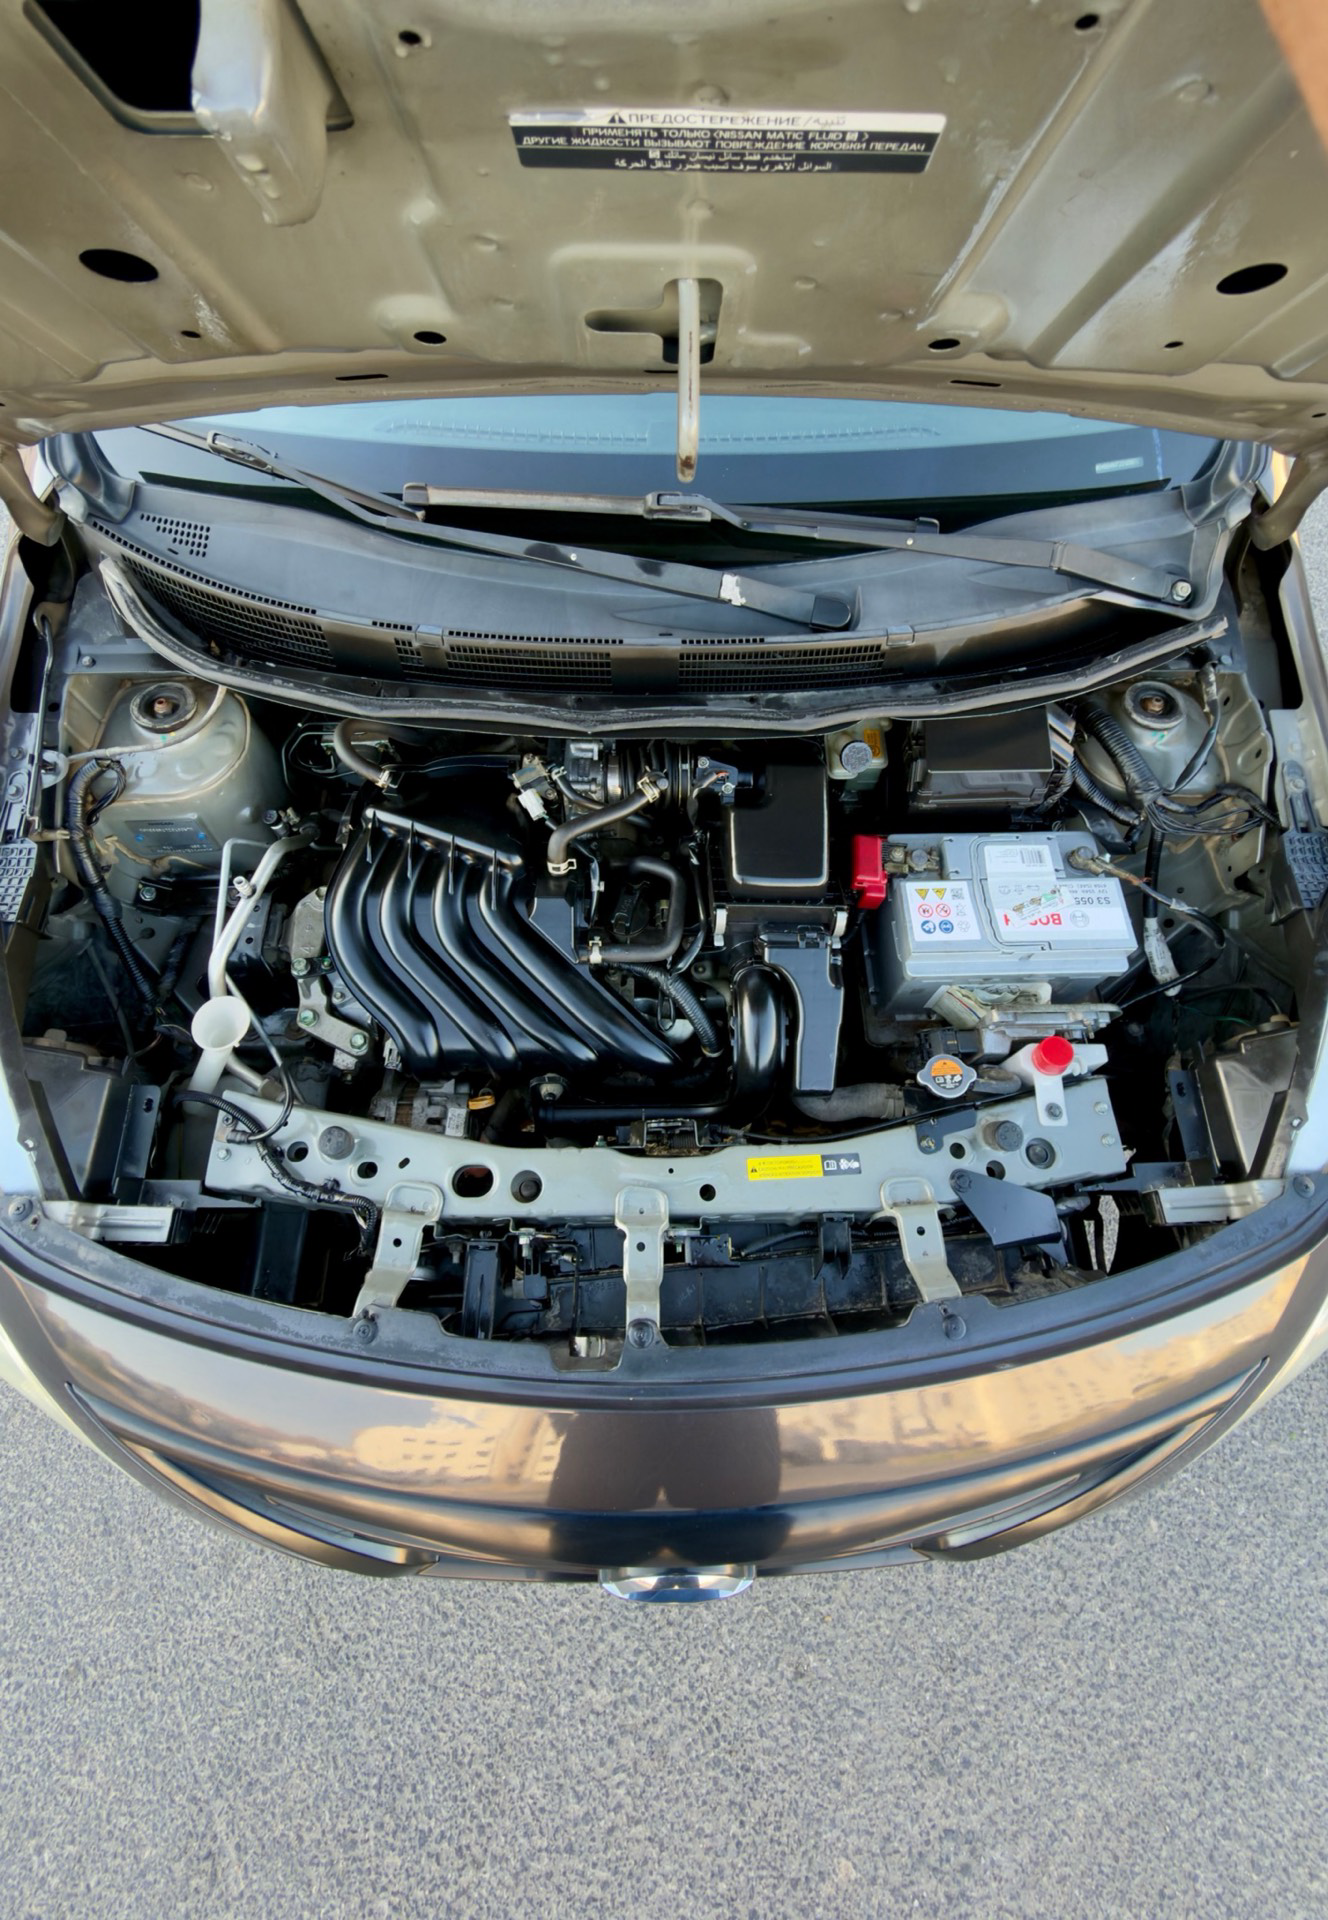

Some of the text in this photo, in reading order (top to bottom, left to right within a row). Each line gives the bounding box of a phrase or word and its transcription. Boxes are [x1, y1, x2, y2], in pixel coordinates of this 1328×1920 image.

[582, 127, 658, 138] ПРИМЕНЯТЬ
[661, 129, 711, 139] ТОЛЬКО
[766, 131, 804, 140] MATIC
[808, 131, 843, 141] FLUID
[522, 136, 926, 152] ДРУГИЕ ЖИДКОСТИ ВЫЗЫВАЮТ ПОВРЕЖДЕНИЕ КОРОБКИ ПЕРЕДАЧ
[1074, 896, 1111, 905] S3 055
